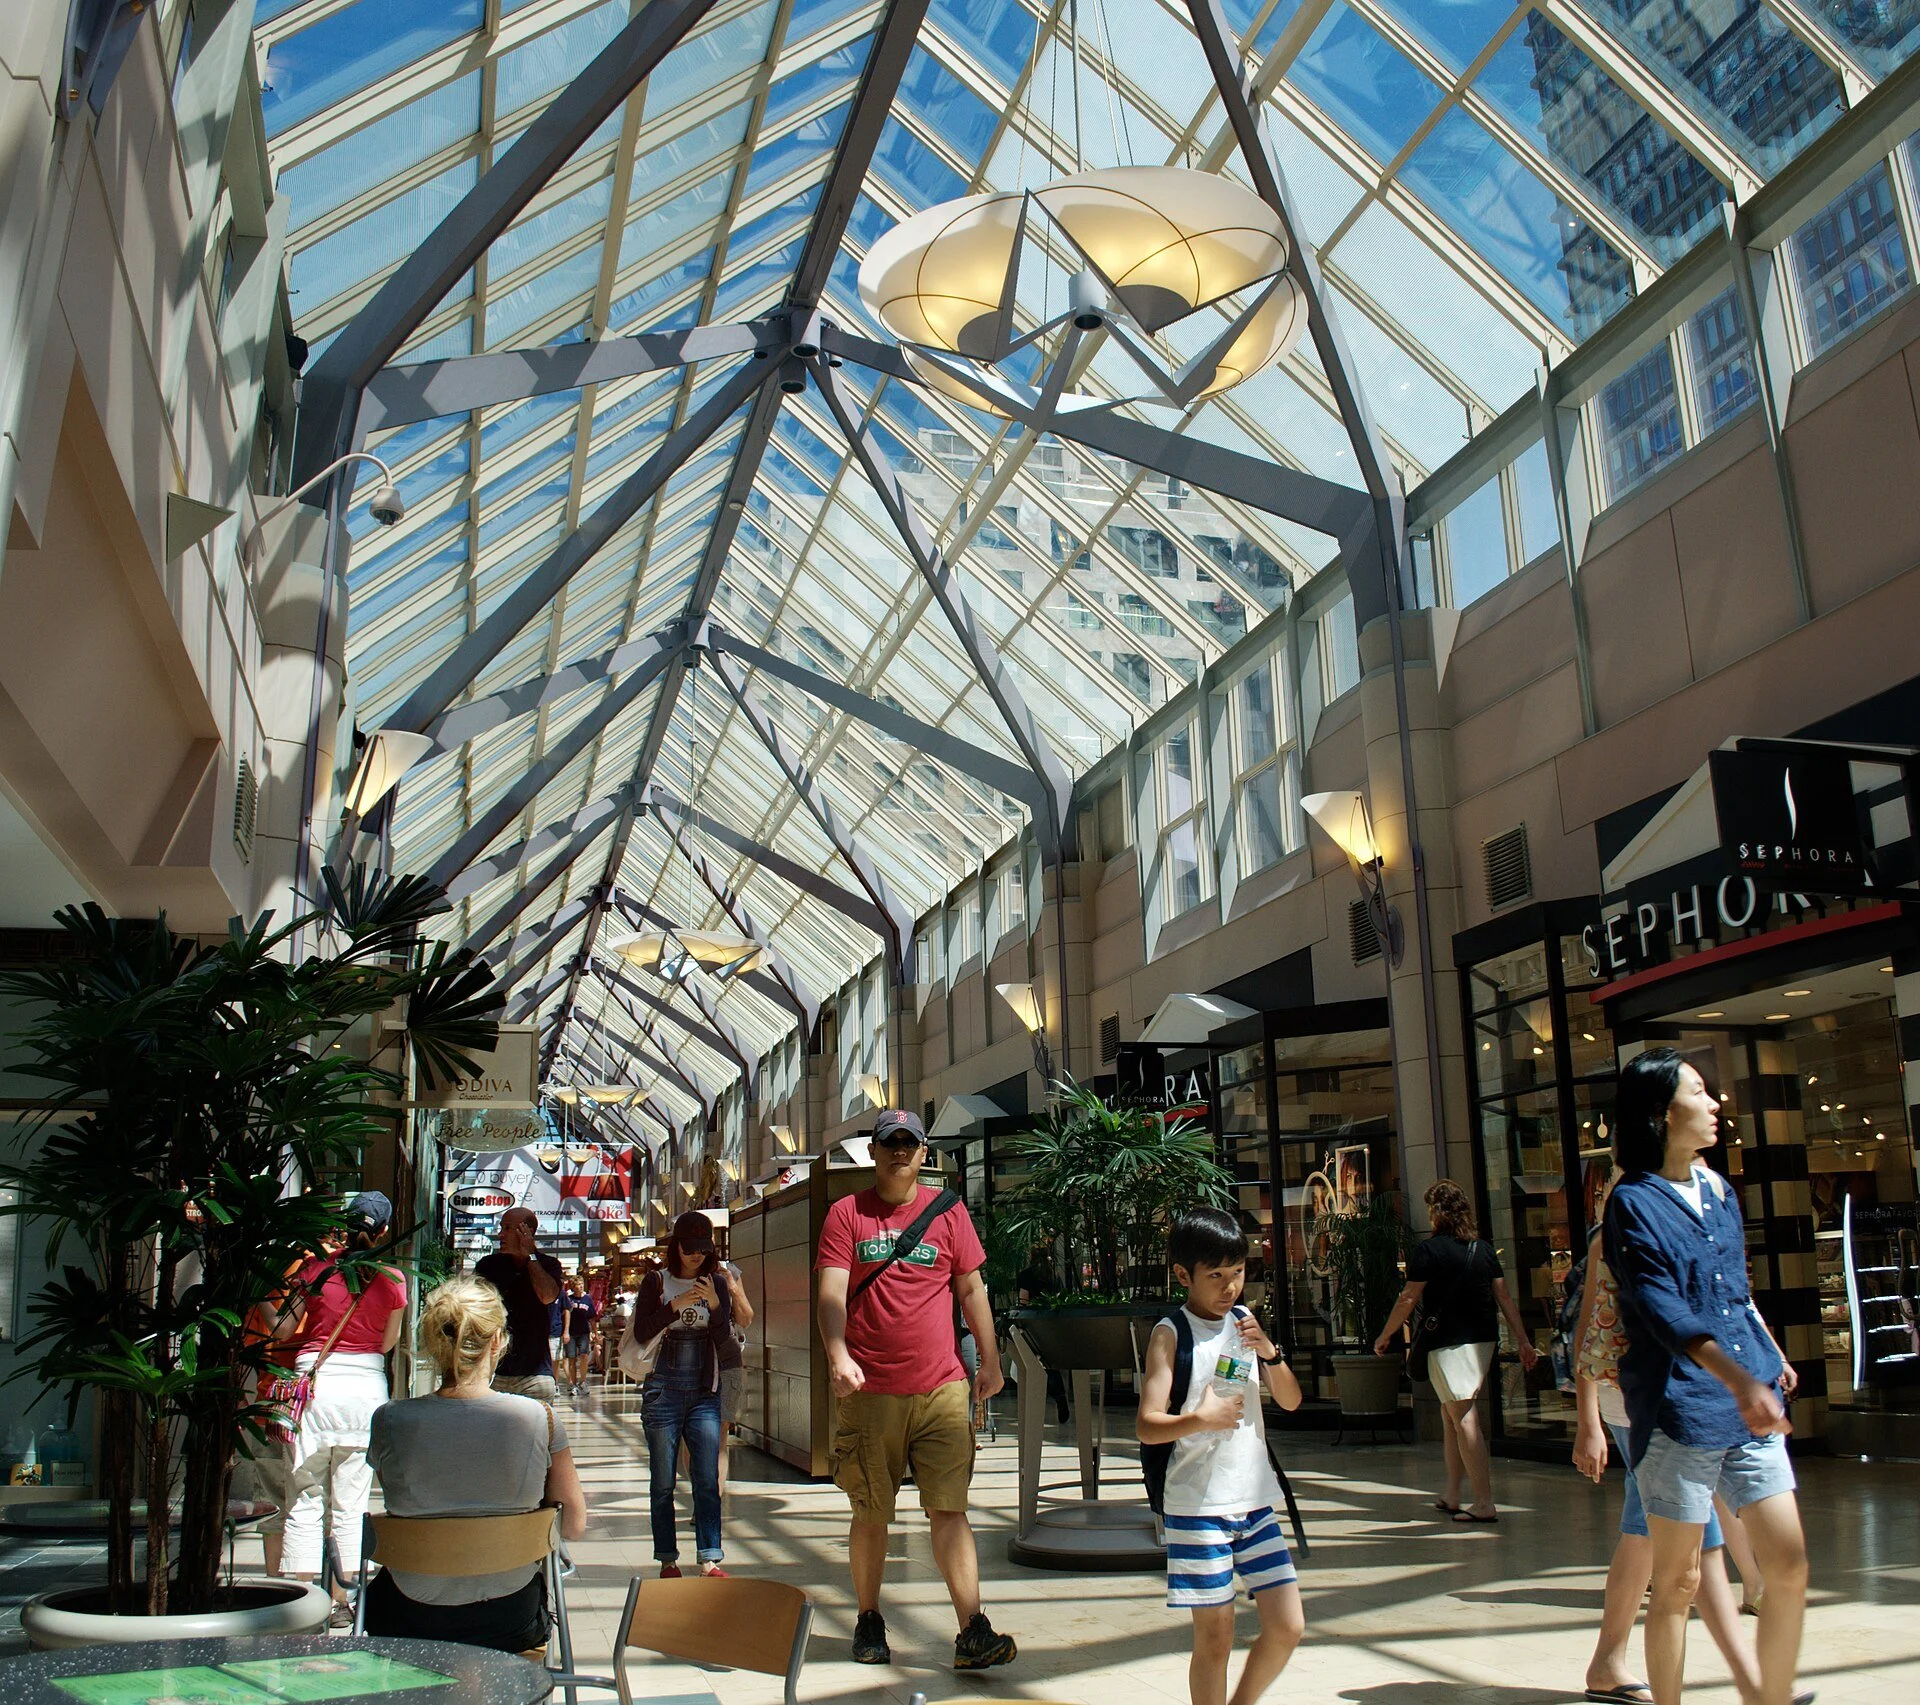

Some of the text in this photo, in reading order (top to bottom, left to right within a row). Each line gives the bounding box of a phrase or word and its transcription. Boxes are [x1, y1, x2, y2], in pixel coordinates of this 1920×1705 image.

[1739, 843, 1854, 864] SEPHORA
[1582, 868, 1873, 978] SEPHO
[434, 1122, 543, 1143] Free People
[490, 1172, 540, 1186] buyer's
[453, 1195, 511, 1207] GameStop
[587, 1205, 623, 1220] Coke
